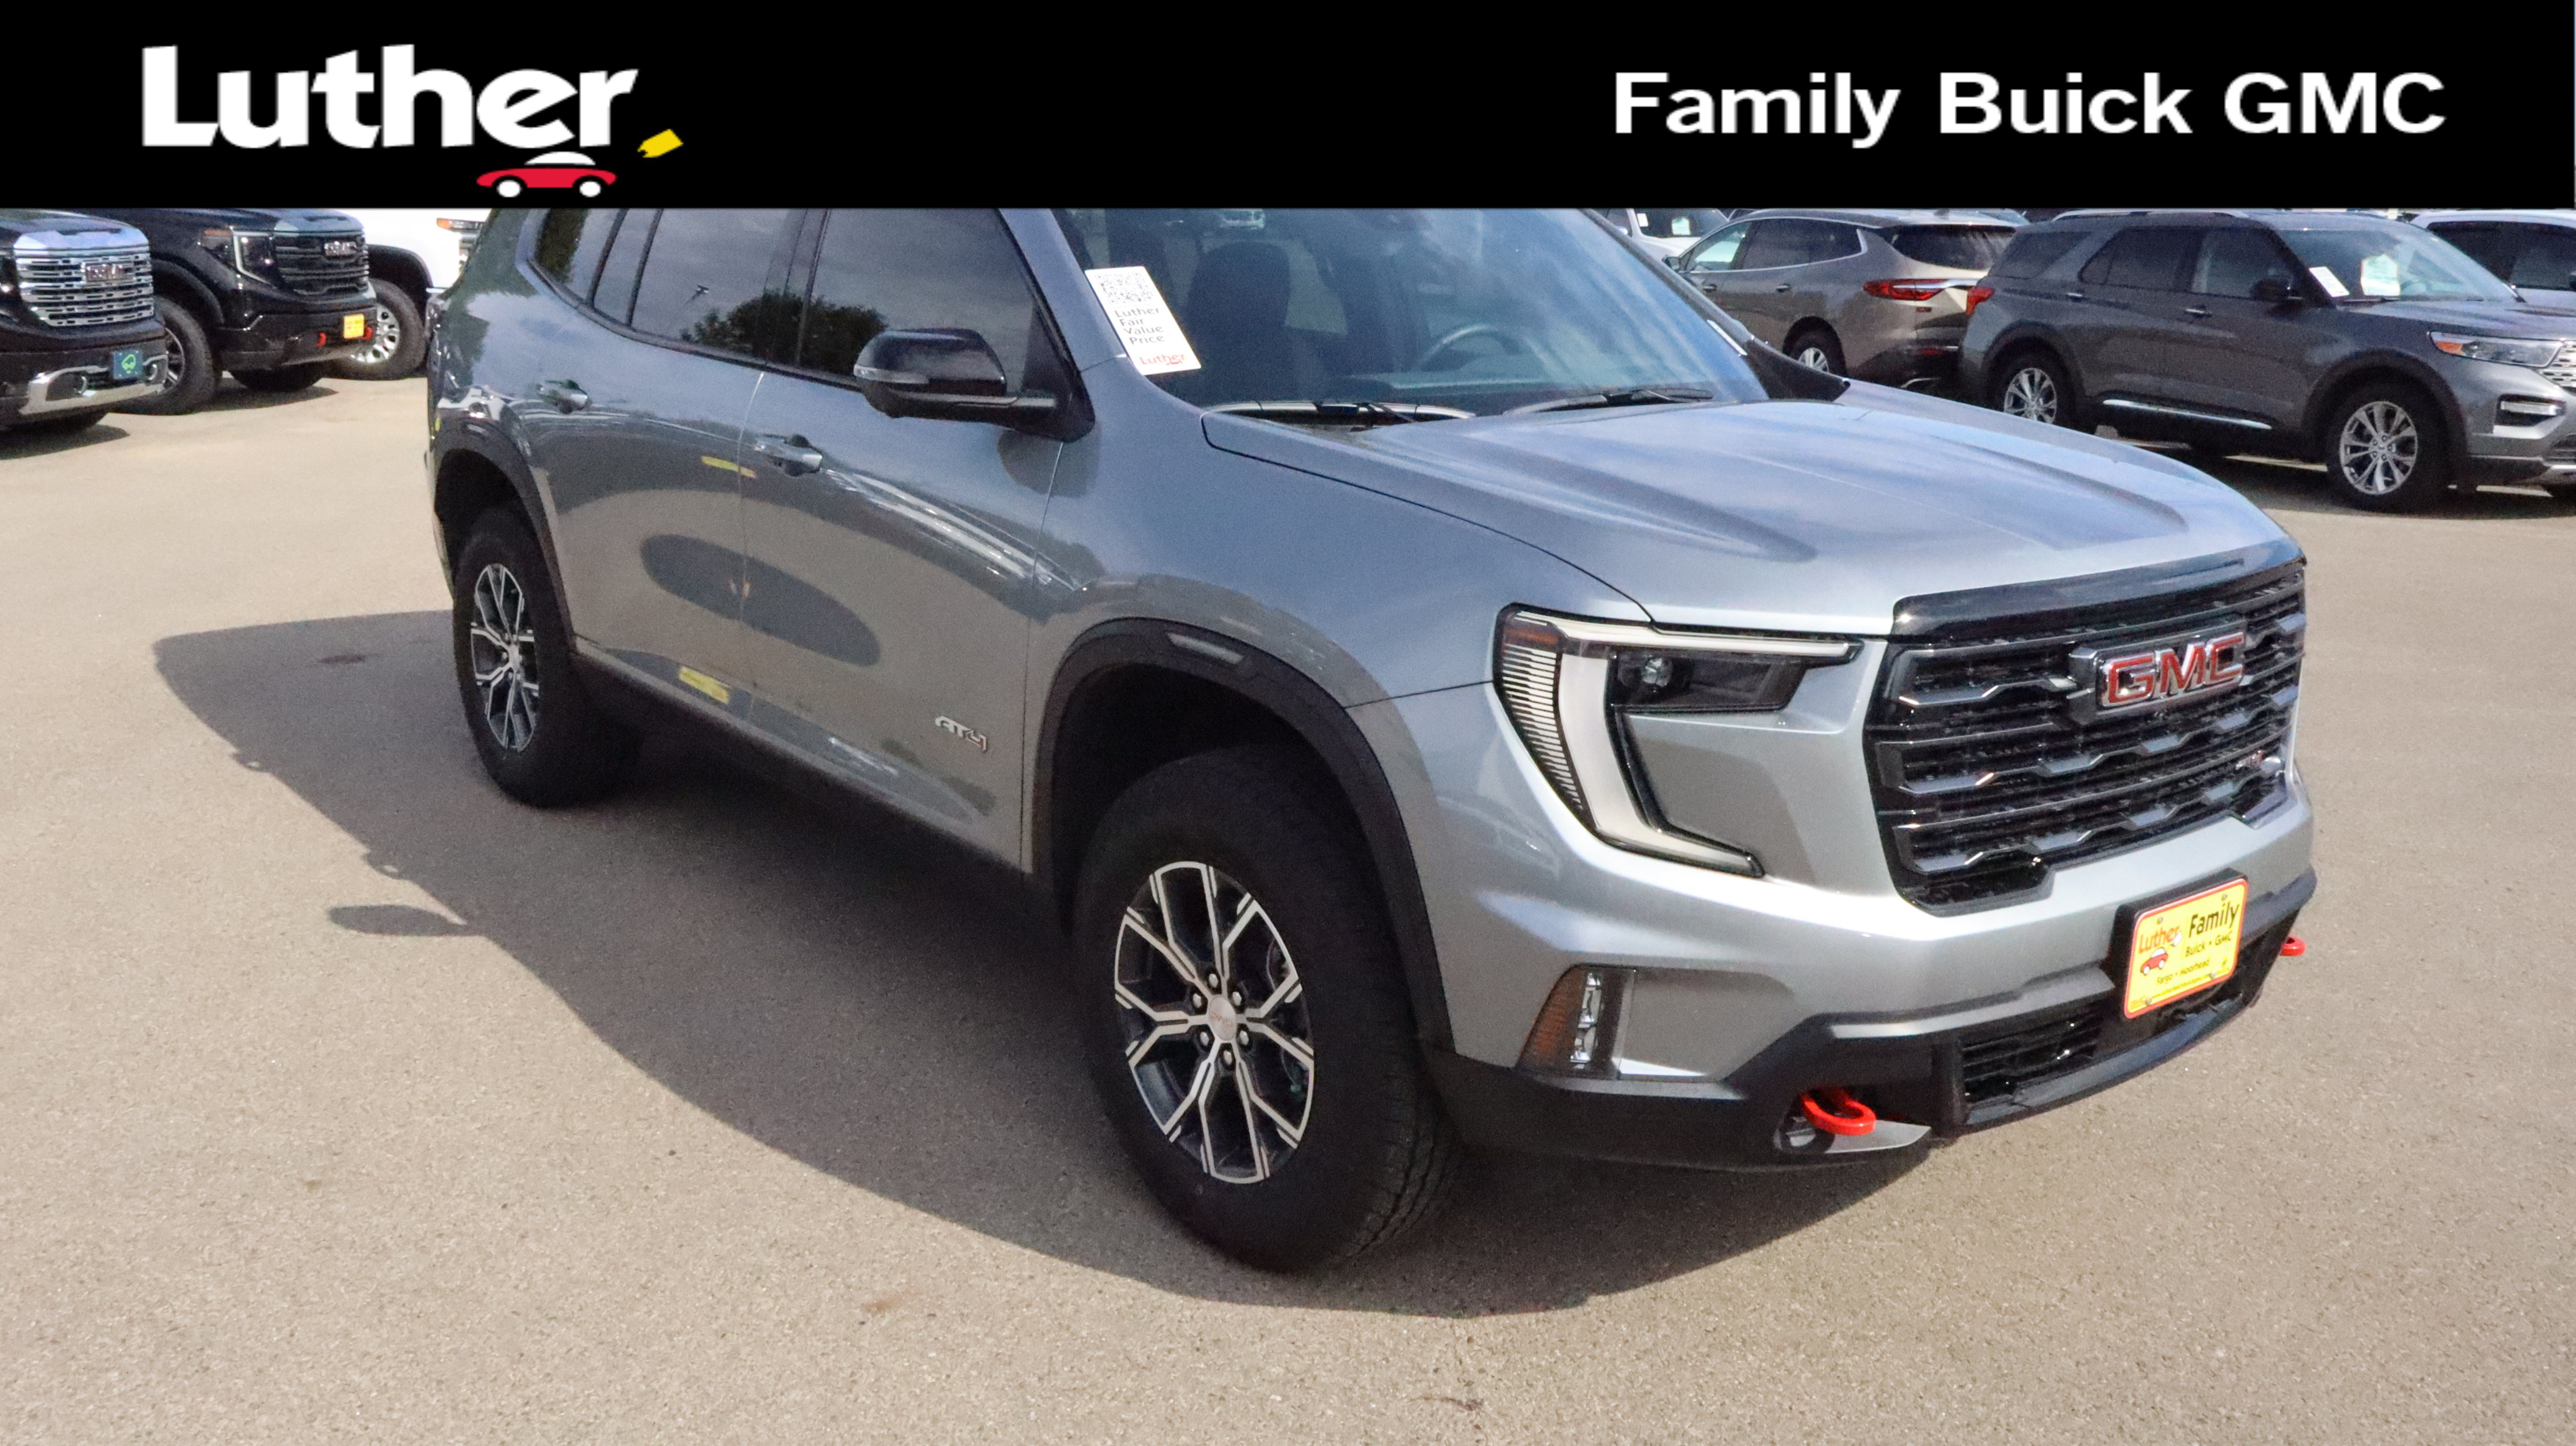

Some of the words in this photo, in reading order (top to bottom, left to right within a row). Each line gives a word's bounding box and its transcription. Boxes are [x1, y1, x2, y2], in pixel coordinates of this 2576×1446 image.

[1114, 308, 1159, 318] Luther
[1119, 317, 1144, 327] Fair
[1123, 326, 1164, 335] Value
[1129, 335, 1165, 345] Price
[1140, 354, 1186, 365] Luther
[2103, 631, 2245, 707] GMC
[935, 715, 987, 751] AT4
[2139, 926, 2180, 953] Luther
[2189, 901, 2239, 937] Family
[2186, 942, 2205, 957] Buick
[2216, 931, 2232, 945] GMC
